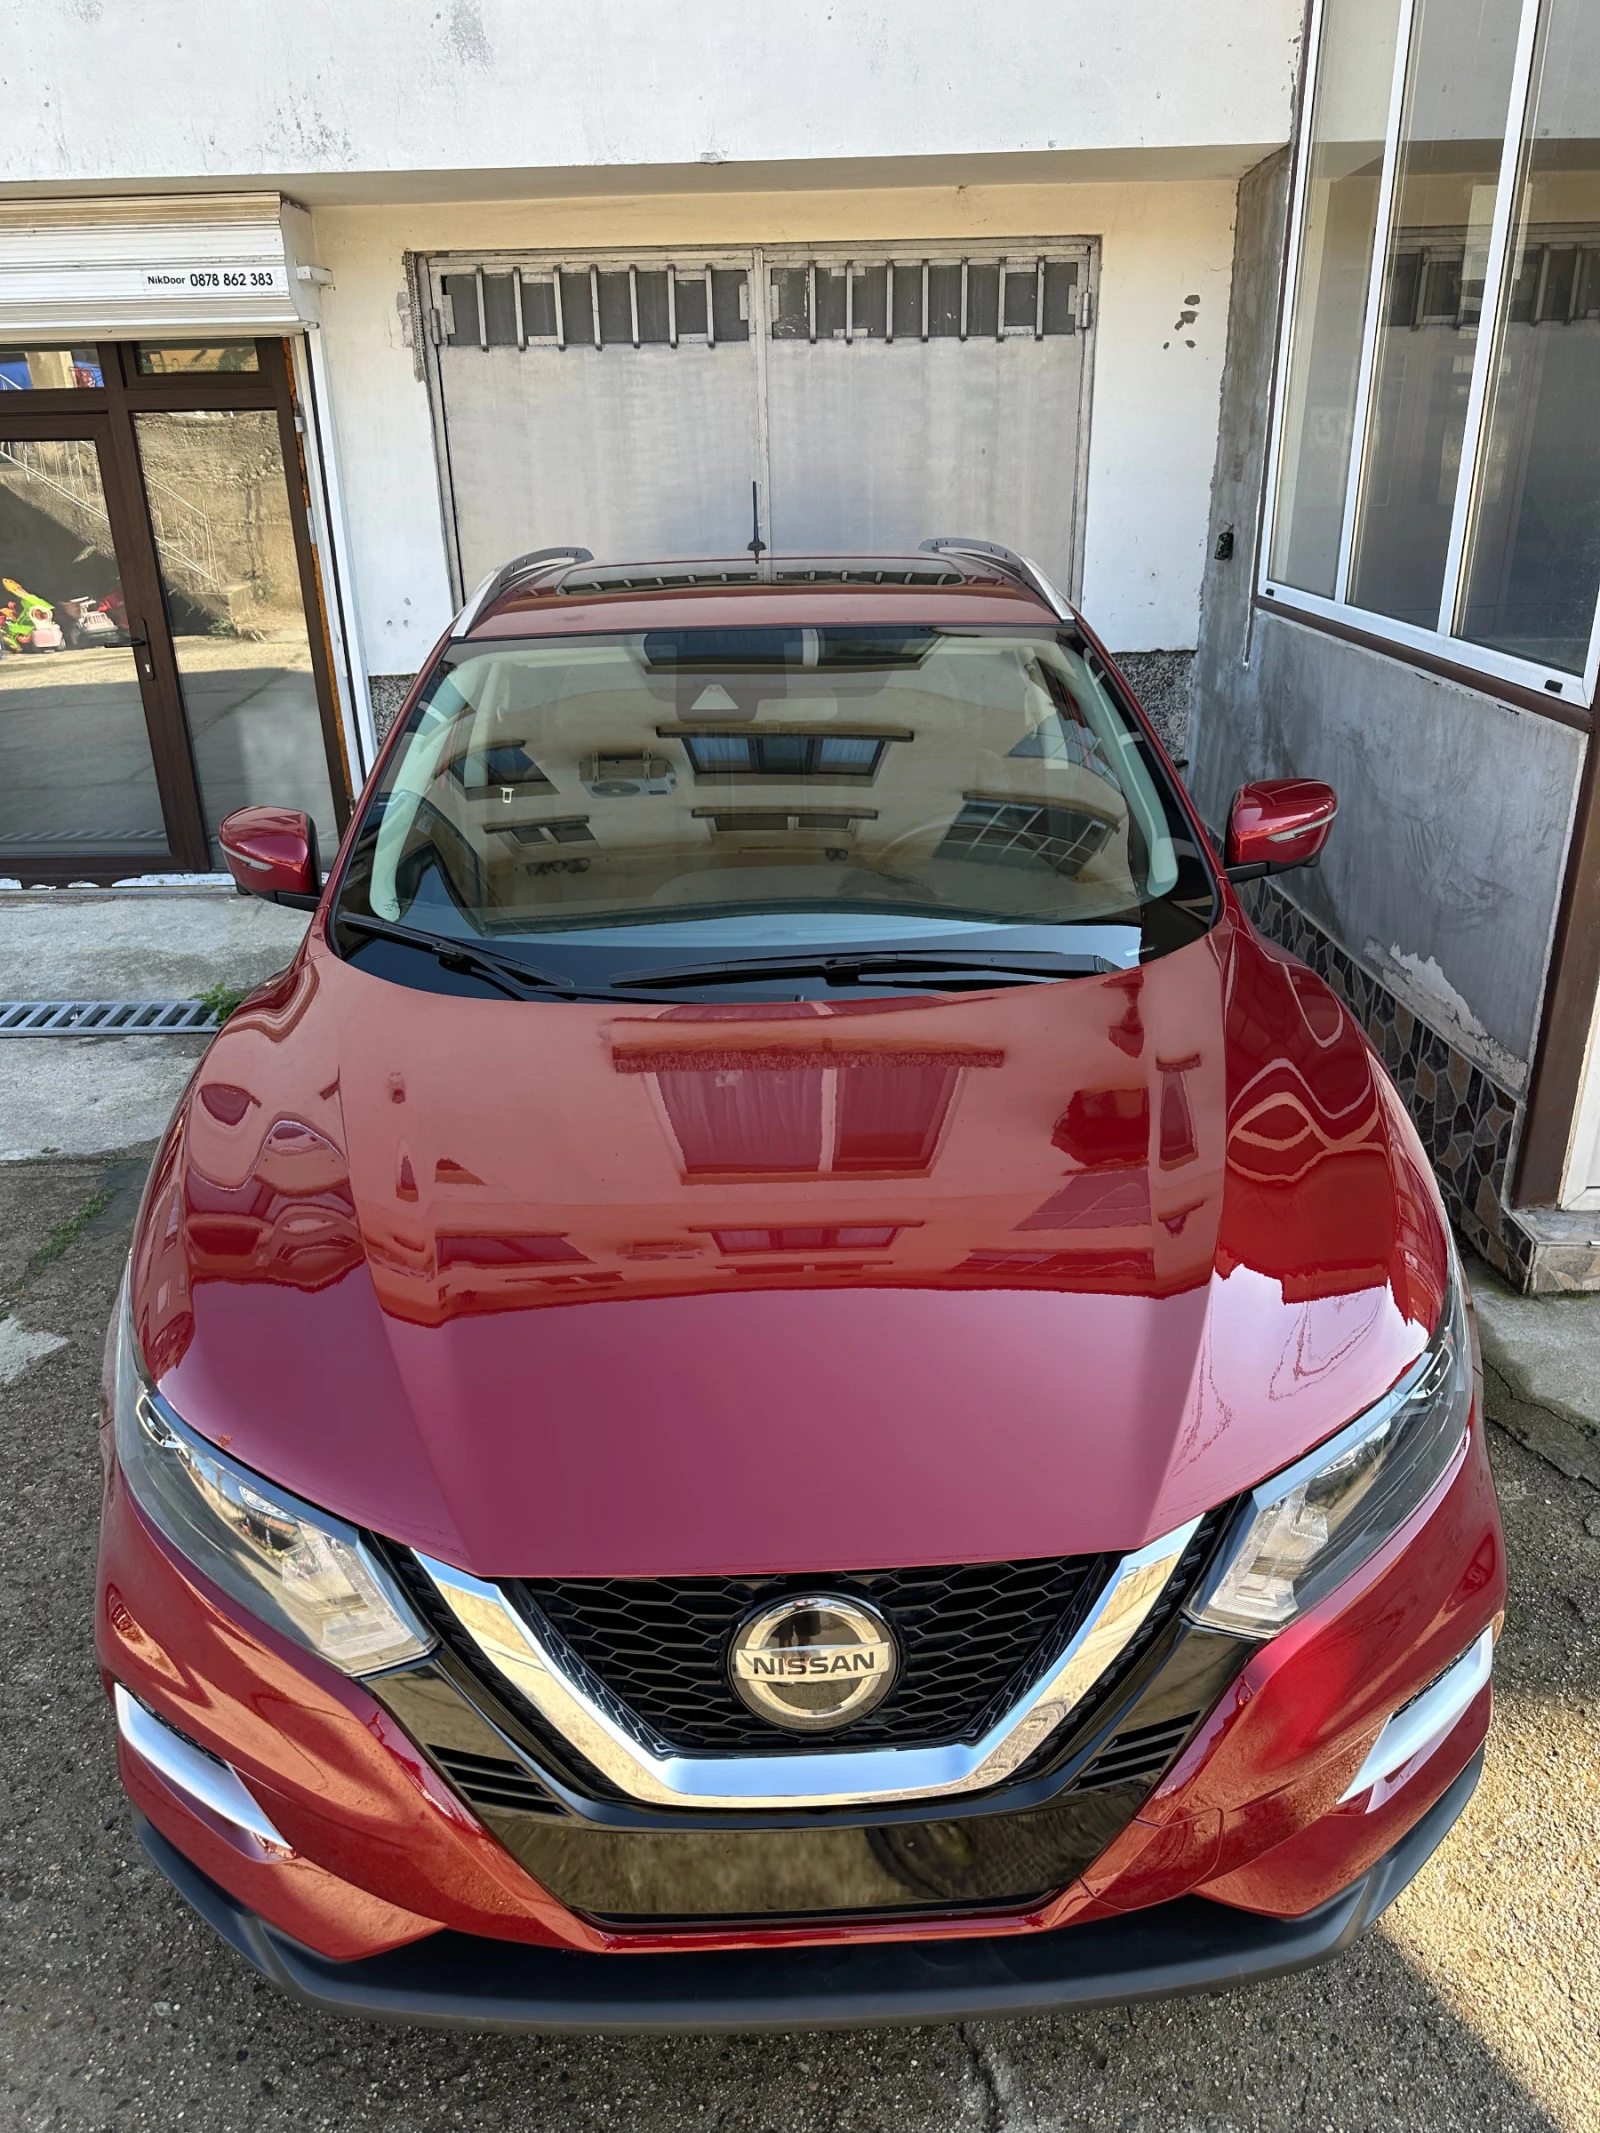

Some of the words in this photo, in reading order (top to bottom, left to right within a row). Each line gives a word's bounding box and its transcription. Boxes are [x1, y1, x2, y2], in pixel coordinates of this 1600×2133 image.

[147, 276, 186, 285] NikDoor
[190, 273, 220, 287] 0878
[223, 273, 247, 286] 862
[250, 272, 274, 286] 383
[753, 1651, 875, 1675] NISSAN
